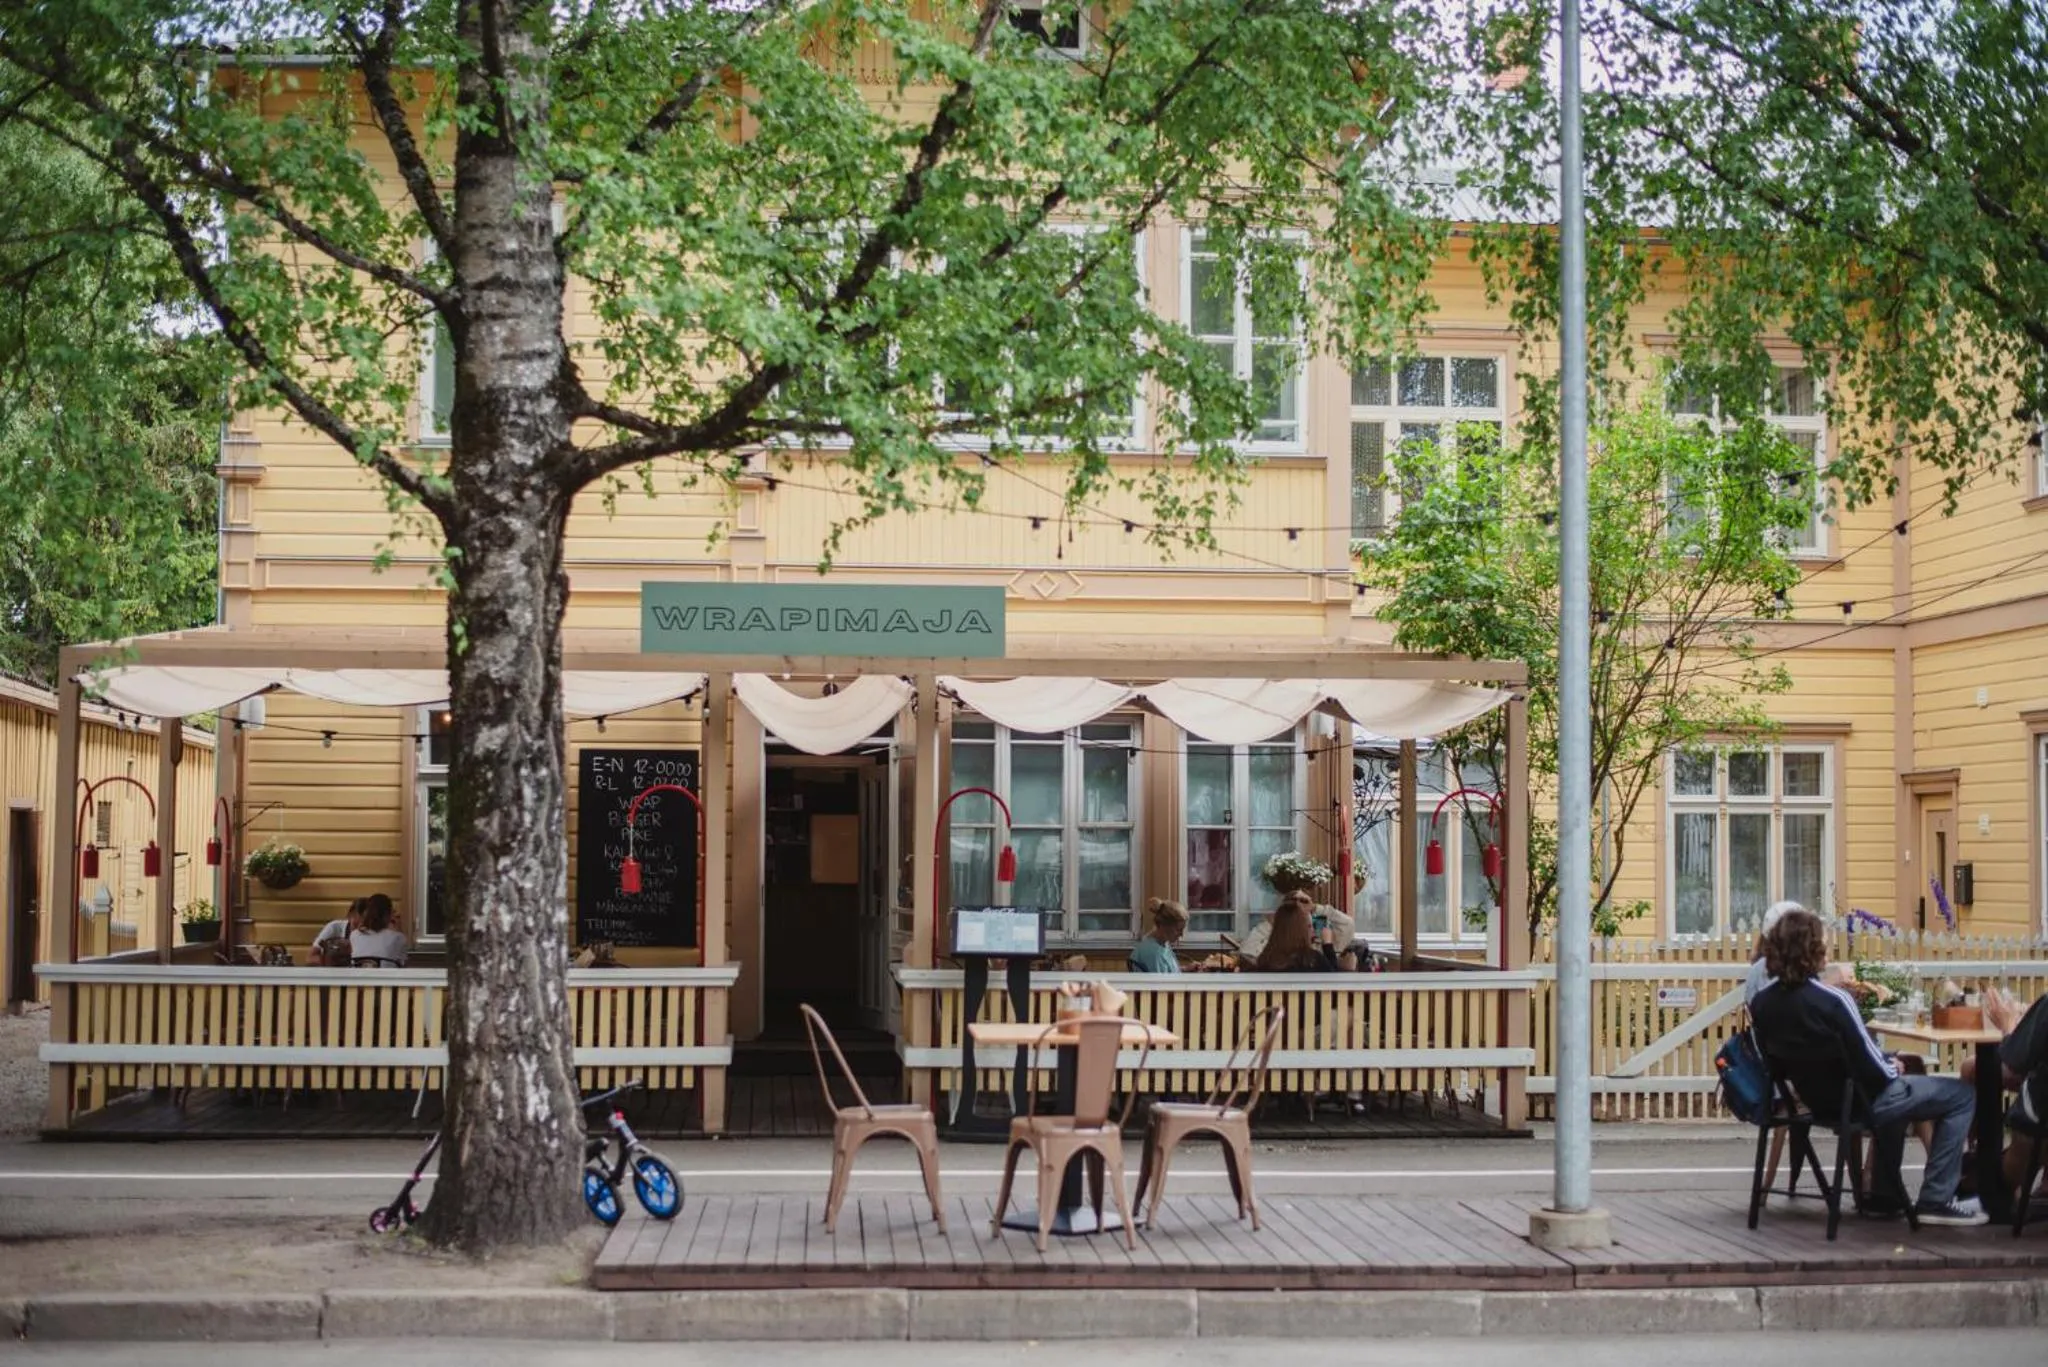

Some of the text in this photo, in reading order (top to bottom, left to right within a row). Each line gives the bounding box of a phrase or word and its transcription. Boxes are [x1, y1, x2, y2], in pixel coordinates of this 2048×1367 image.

[651, 606, 993, 634] WRAPIMAJA
[592, 756, 624, 773] E-N
[608, 811, 662, 828] BUGER
